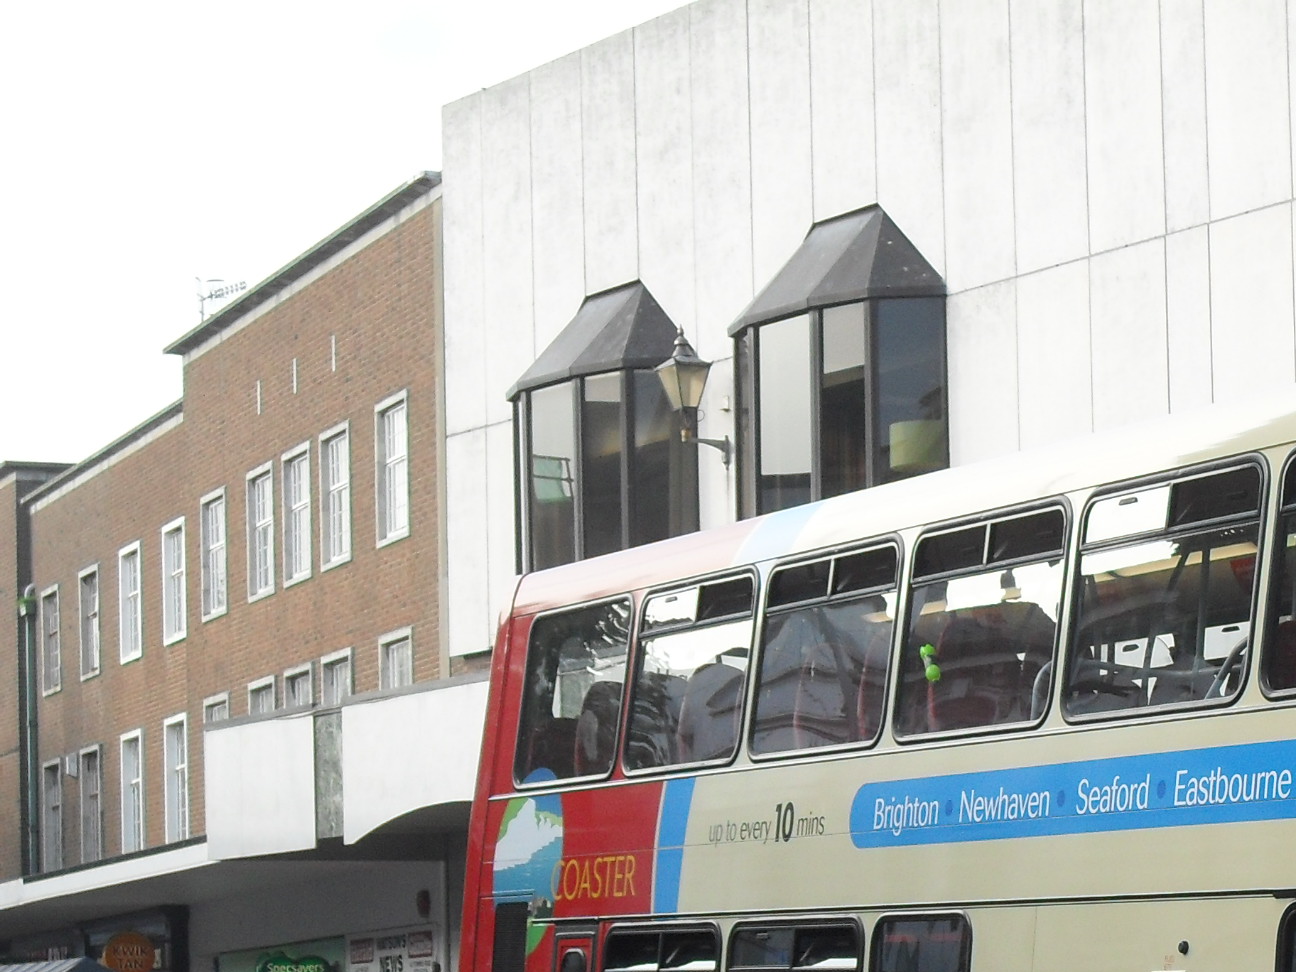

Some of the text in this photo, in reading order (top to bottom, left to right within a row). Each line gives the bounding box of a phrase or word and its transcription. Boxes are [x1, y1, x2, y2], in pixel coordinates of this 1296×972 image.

[873, 798, 939, 836] Brighton
[958, 787, 1050, 823] Newhaven
[1075, 774, 1150, 815] Seaford
[1174, 766, 1292, 807] Eastbourne
[708, 802, 826, 844] up to every 10 mins
[551, 854, 637, 901] COASTER
[112, 945, 147, 958] KWIK
[117, 958, 143, 970] TAN
